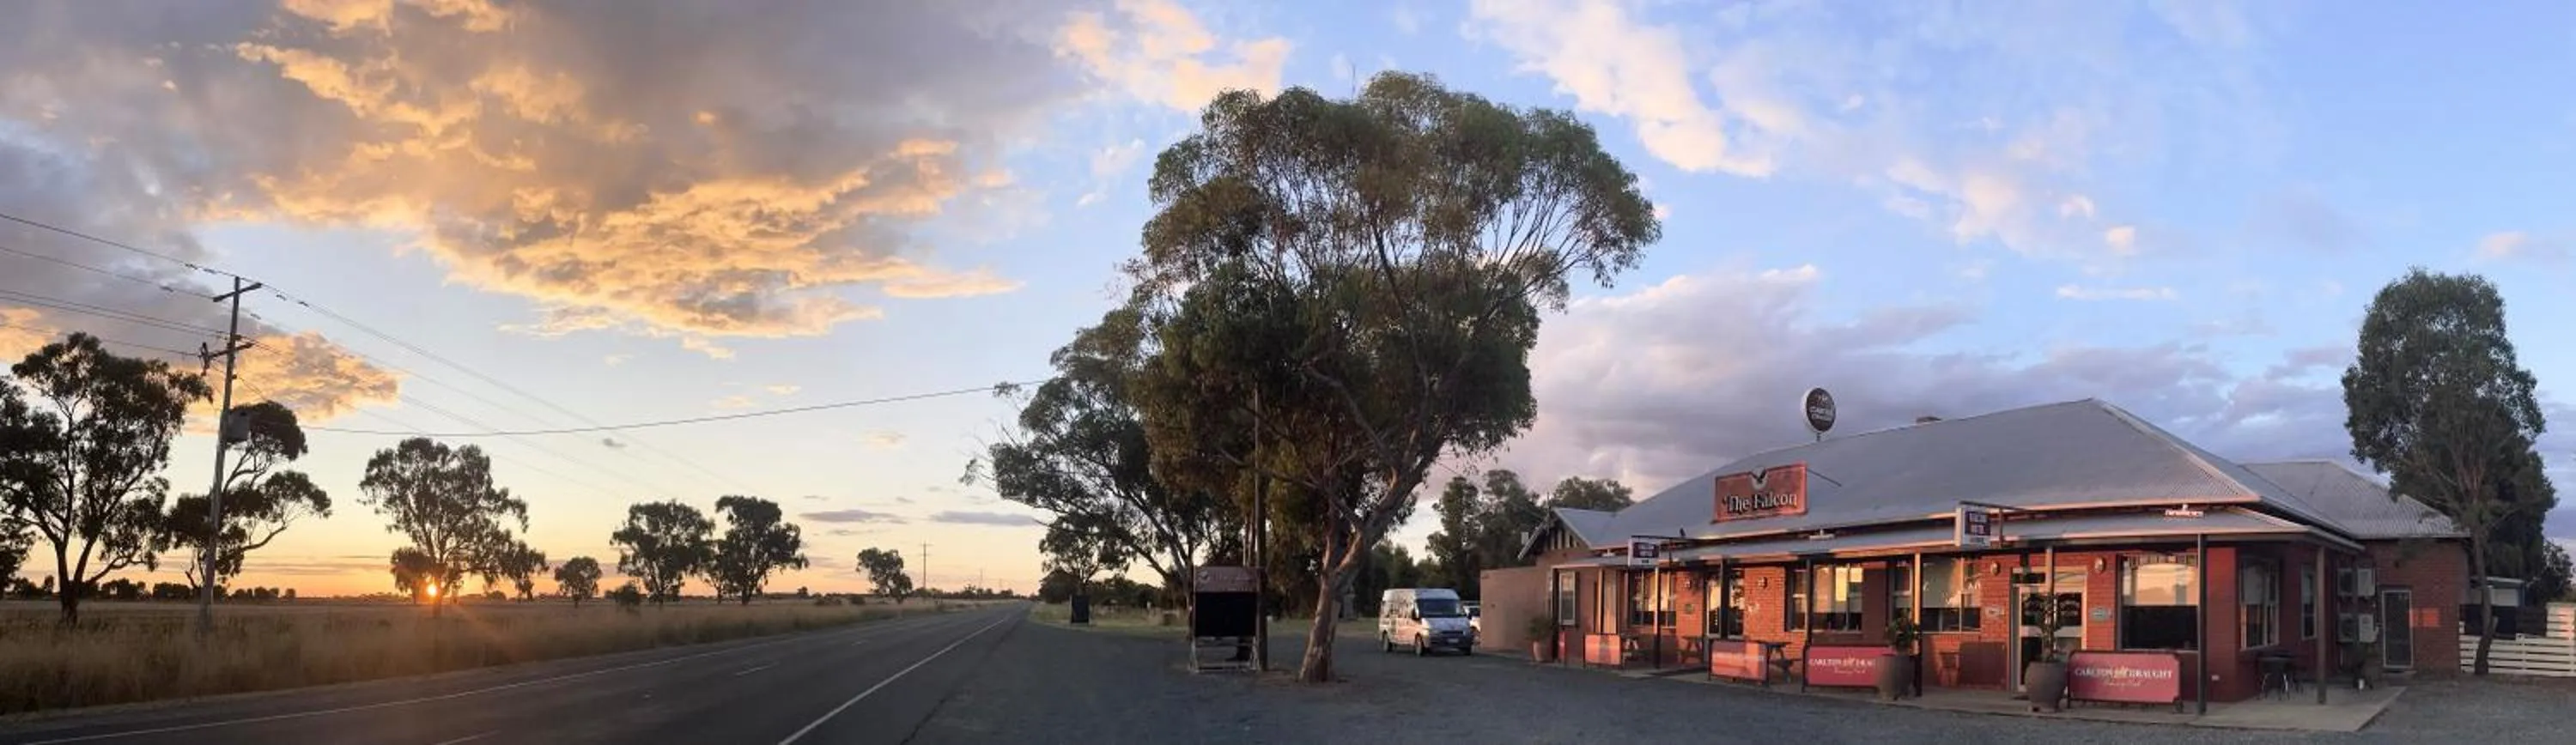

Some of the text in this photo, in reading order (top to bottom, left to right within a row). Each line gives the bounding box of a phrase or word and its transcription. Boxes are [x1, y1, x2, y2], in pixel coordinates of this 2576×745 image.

[1722, 490, 1798, 514] The Falcon
[2075, 667, 2172, 679] CARLTON DRAUGHT
